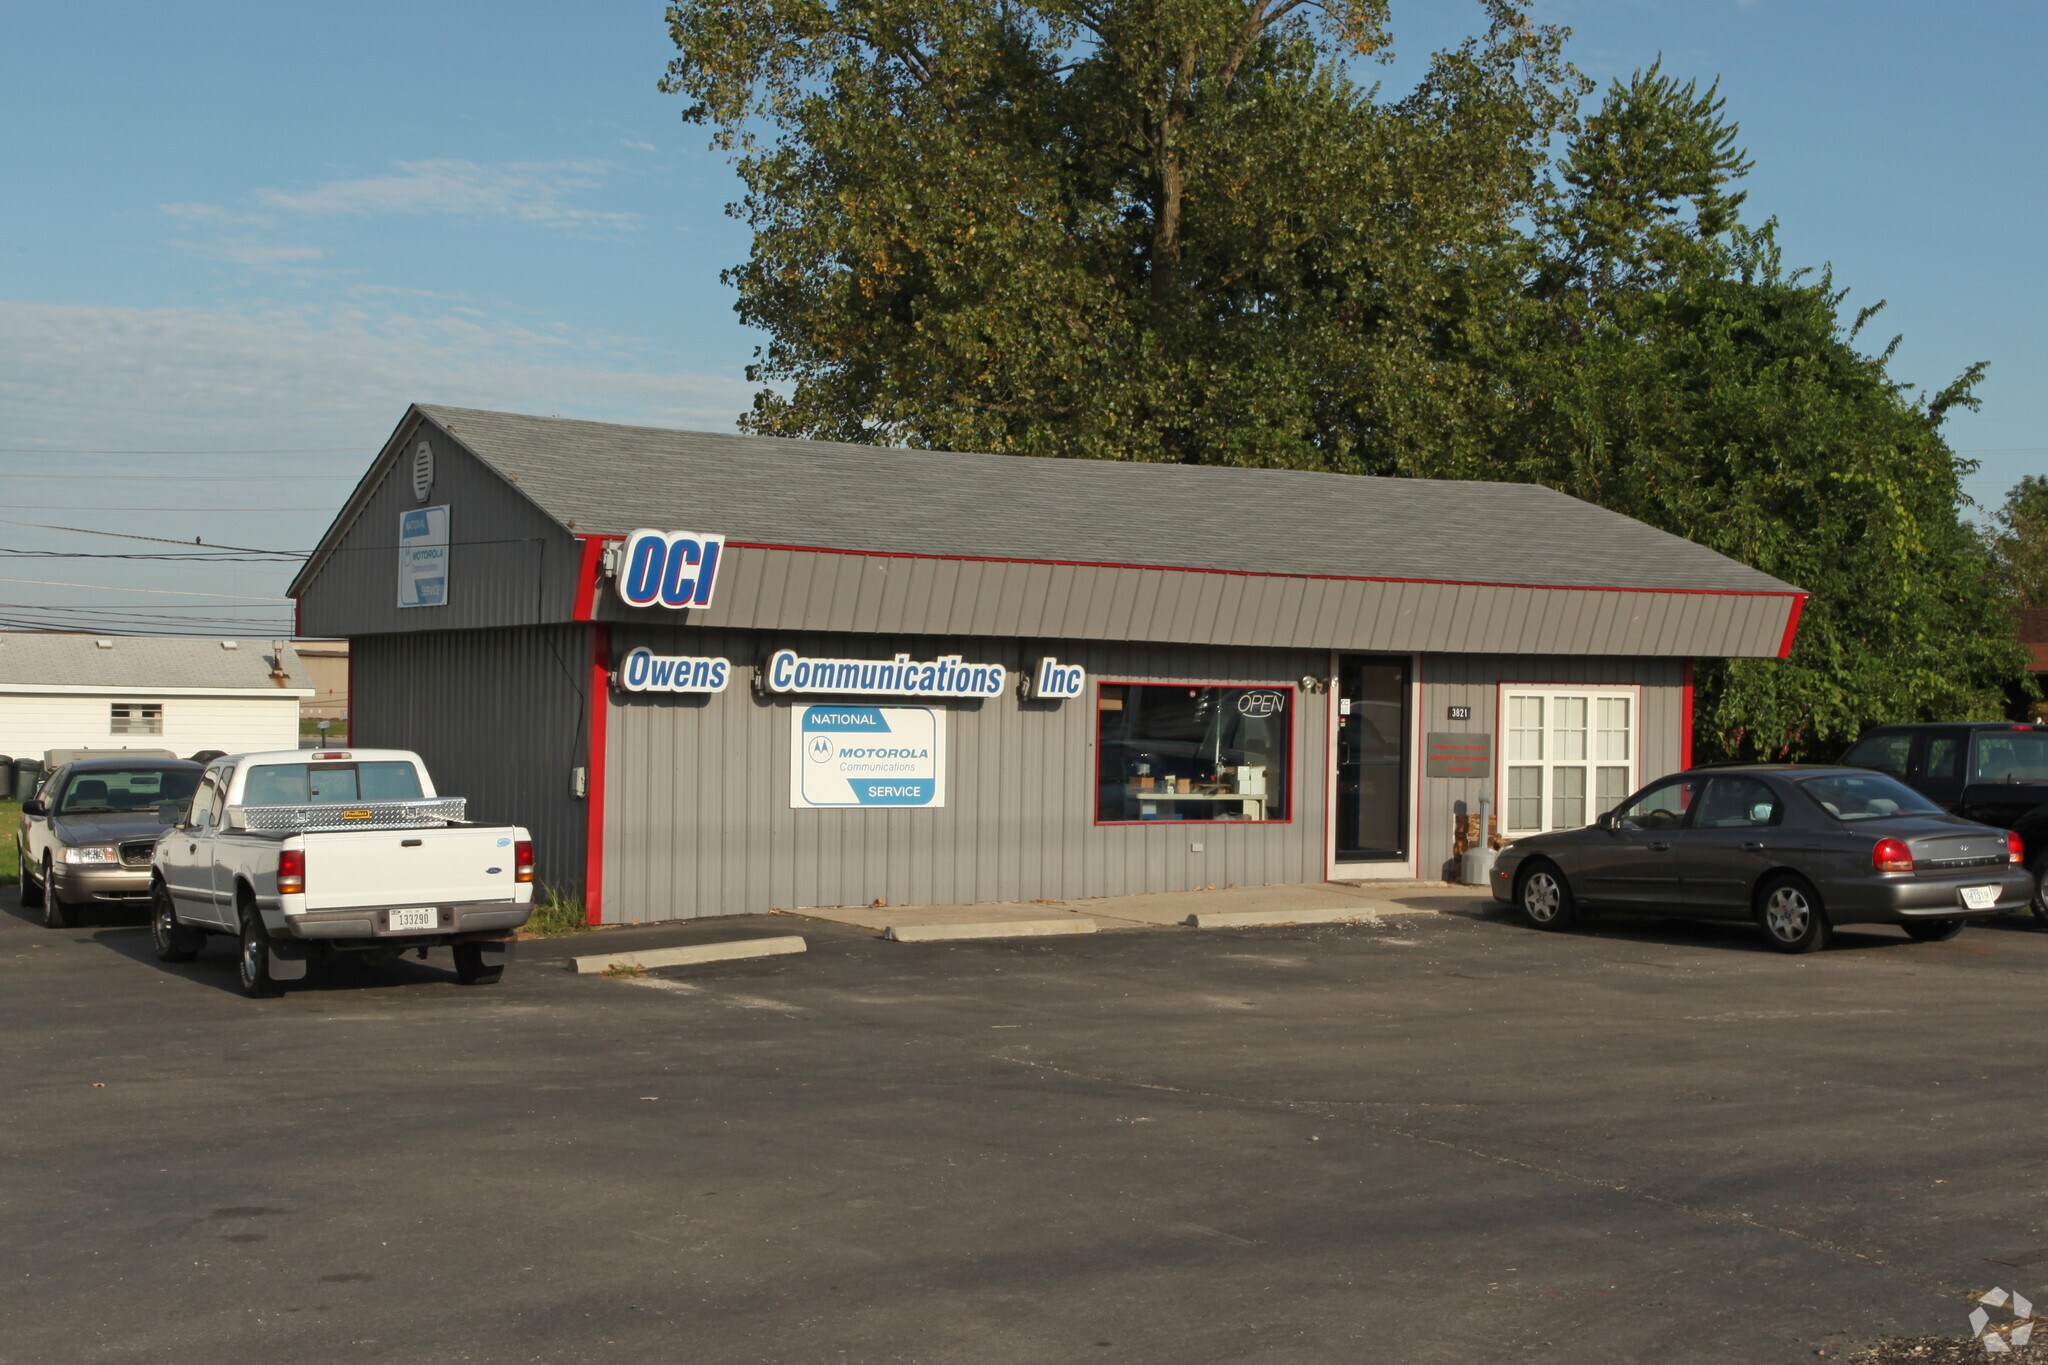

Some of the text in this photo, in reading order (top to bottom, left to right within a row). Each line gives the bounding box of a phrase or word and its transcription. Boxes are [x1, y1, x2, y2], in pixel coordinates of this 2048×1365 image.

[412, 548, 443, 560] MOTOROLA
[626, 536, 720, 606] OCI
[628, 651, 1082, 694] Owens Communications Inc
[1237, 694, 1286, 713] OPEN
[1451, 708, 1468, 718] 3821
[811, 714, 877, 725] NATIONAL
[838, 748, 928, 759] MOTOROLA
[839, 761, 916, 772] Communications
[868, 786, 921, 797] SERVICE
[399, 913, 429, 926] 133290
